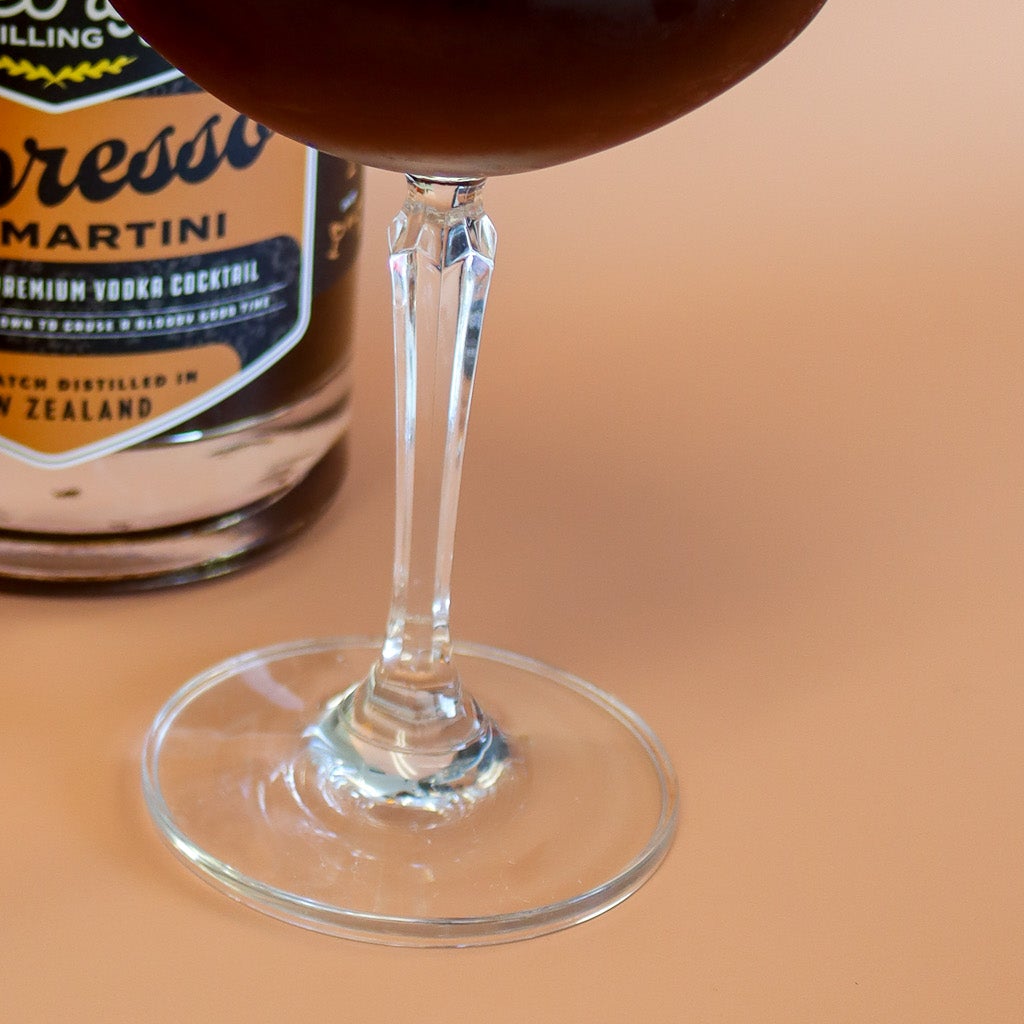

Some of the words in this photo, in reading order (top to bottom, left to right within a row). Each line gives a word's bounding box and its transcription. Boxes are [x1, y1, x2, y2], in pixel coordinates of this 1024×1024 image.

[1, 212, 227, 251] MARTINI
[93, 275, 164, 303] VODKA
[170, 259, 260, 297] COCKTAIL
[57, 375, 167, 392] DISTILLED
[25, 395, 153, 422] ZEALAND
